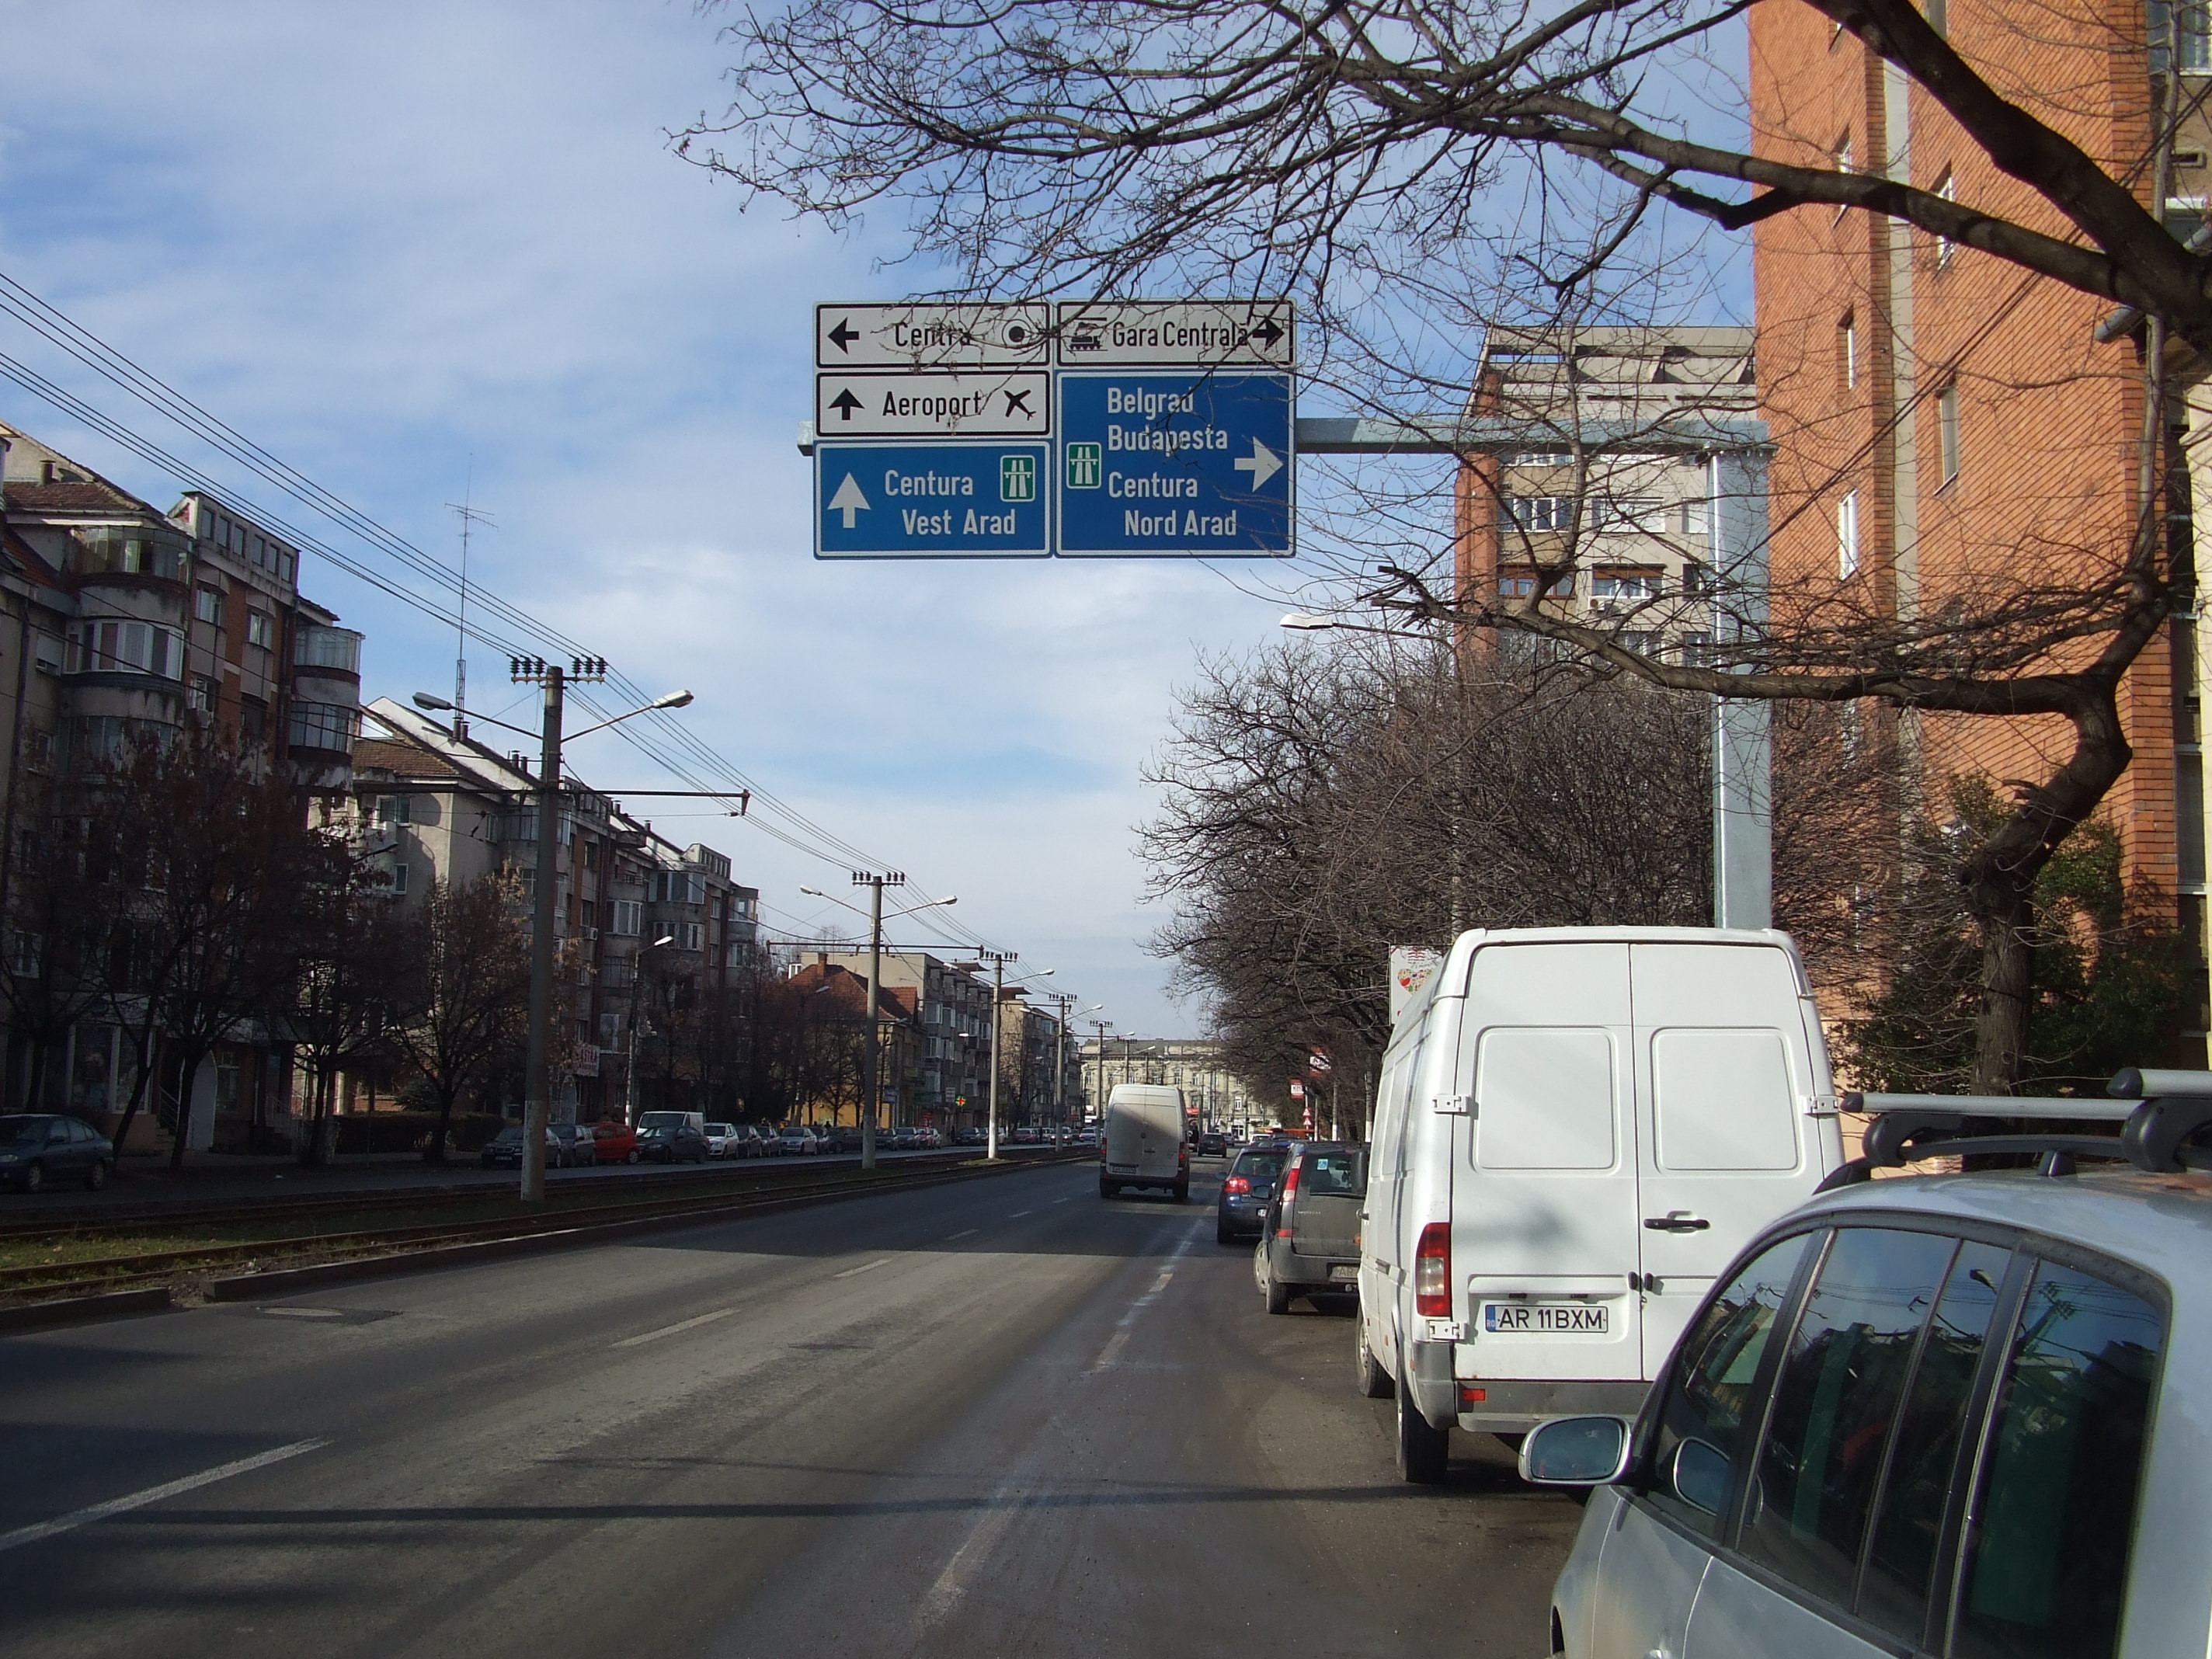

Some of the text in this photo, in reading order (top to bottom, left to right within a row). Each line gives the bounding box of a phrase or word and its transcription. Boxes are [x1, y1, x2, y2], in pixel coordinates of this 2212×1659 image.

[1112, 321, 1248, 346] Gara Centrală
[882, 391, 982, 423] Aeroport
[1108, 387, 1194, 420] Belgrad
[1108, 425, 1228, 457] Budapesta
[885, 470, 973, 496] Centura
[1108, 471, 1198, 498] Centura
[902, 509, 1016, 535] Vest Arad
[1125, 510, 1236, 536] Nord Arad
[1499, 1309, 1602, 1329] AR 11BXM
